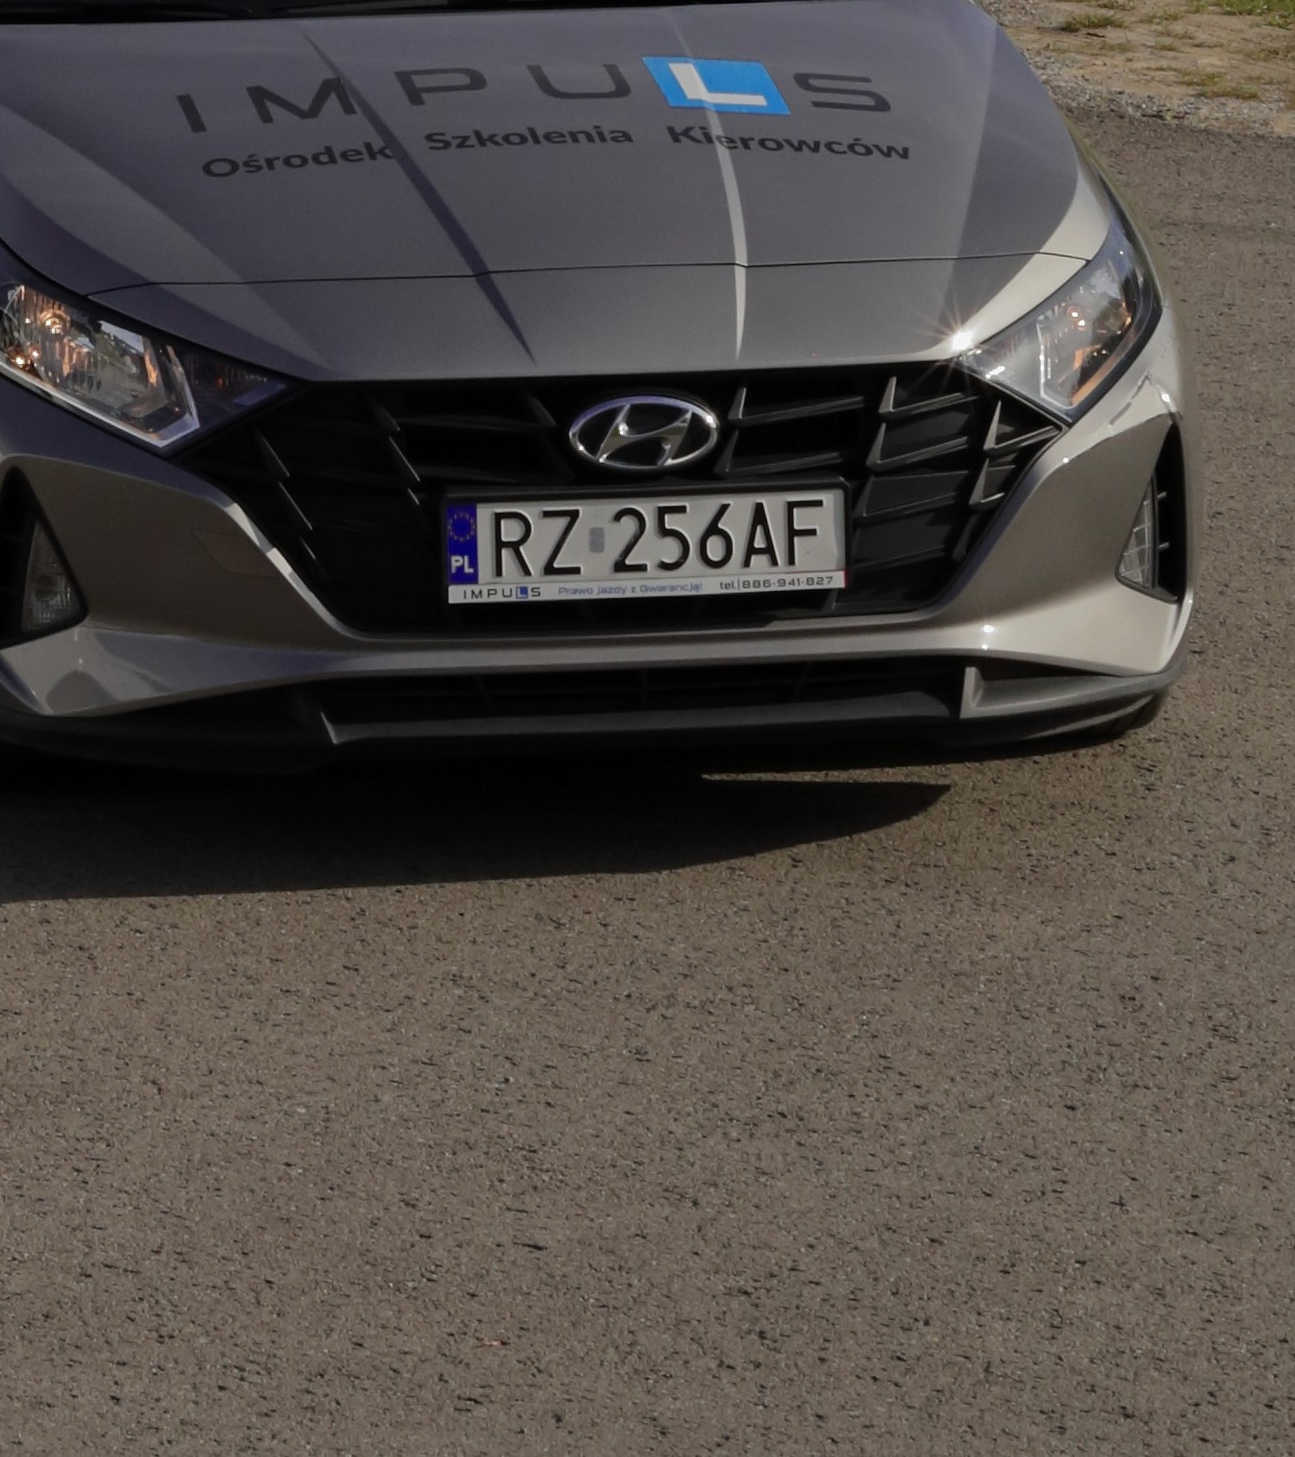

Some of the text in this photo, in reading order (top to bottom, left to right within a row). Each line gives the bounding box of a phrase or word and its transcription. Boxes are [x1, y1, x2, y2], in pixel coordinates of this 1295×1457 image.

[176, 62, 892, 133] IMPULS
[201, 124, 910, 178] Ośrodek Szkolenia Kierowców
[494, 499, 824, 578] RZ 256AF
[450, 555, 474, 574] PL
[463, 586, 541, 600] IMPULS
[558, 586, 593, 595] Prawo
[597, 583, 627, 595] jazdy
